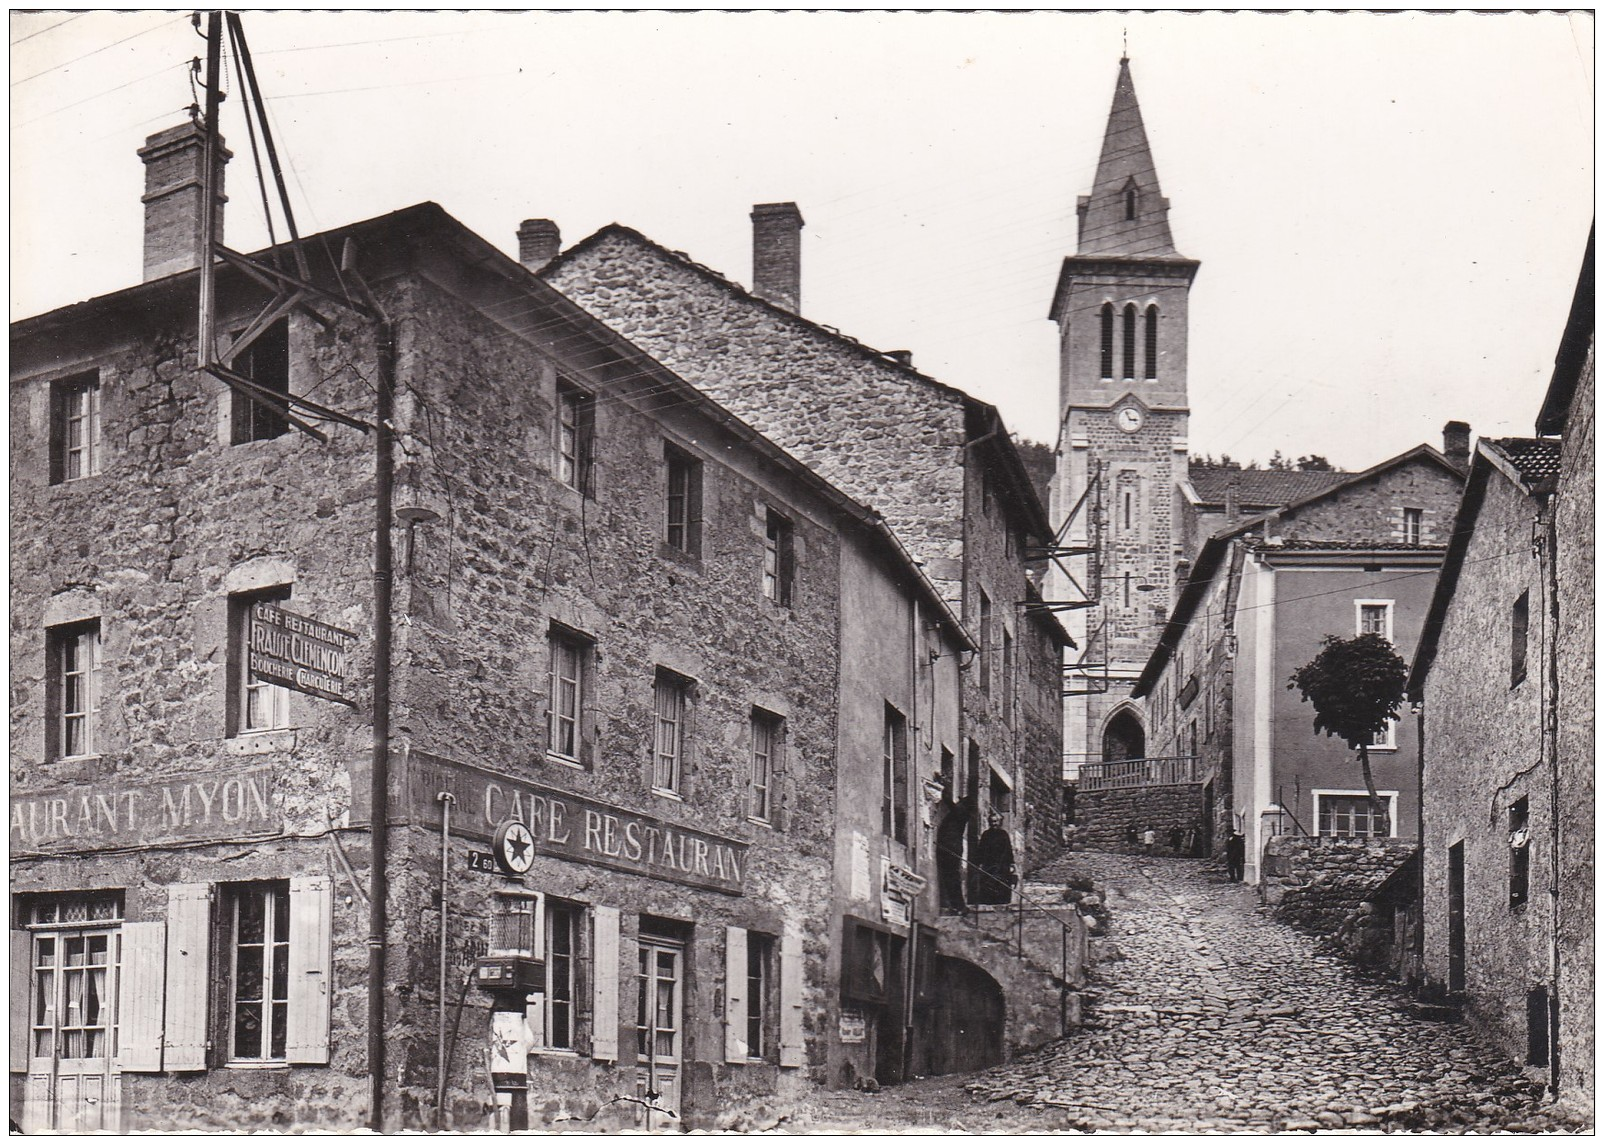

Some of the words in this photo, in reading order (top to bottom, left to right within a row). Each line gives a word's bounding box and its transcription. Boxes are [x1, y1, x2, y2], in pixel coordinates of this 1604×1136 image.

[256, 606, 281, 626] CAFE
[285, 615, 345, 647] RESTAURANT
[250, 652, 294, 681] BOUCHERIE
[296, 667, 343, 696] CHARCUTERIE
[161, 776, 269, 830] MYON
[485, 783, 572, 845] CAFE
[472, 852, 479, 868] 2
[482, 859, 493, 870] 60
